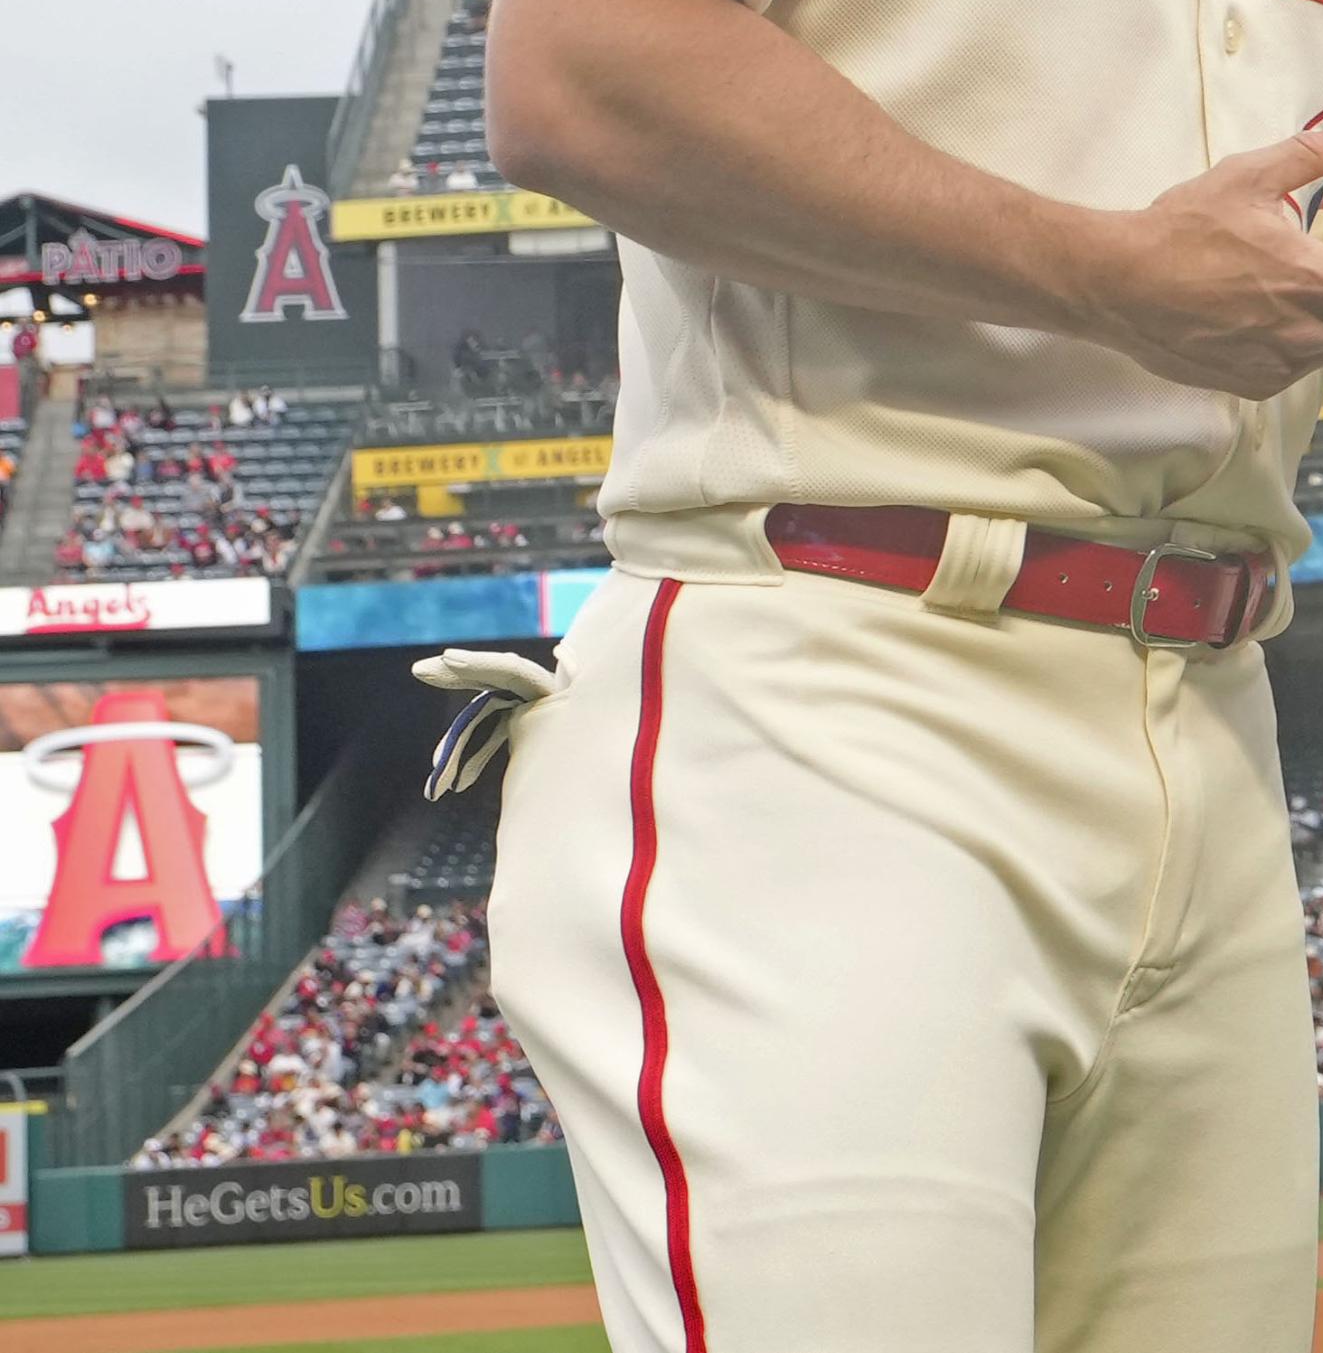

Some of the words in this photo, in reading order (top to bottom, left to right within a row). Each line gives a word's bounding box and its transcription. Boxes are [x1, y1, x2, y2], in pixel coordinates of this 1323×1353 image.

[41, 227, 182, 285] PATIO
[239, 164, 348, 322] A
[26, 583, 152, 635] Angels
[20, 689, 241, 968] A
[144, 1174, 463, 1229] HeGetsUs.com
